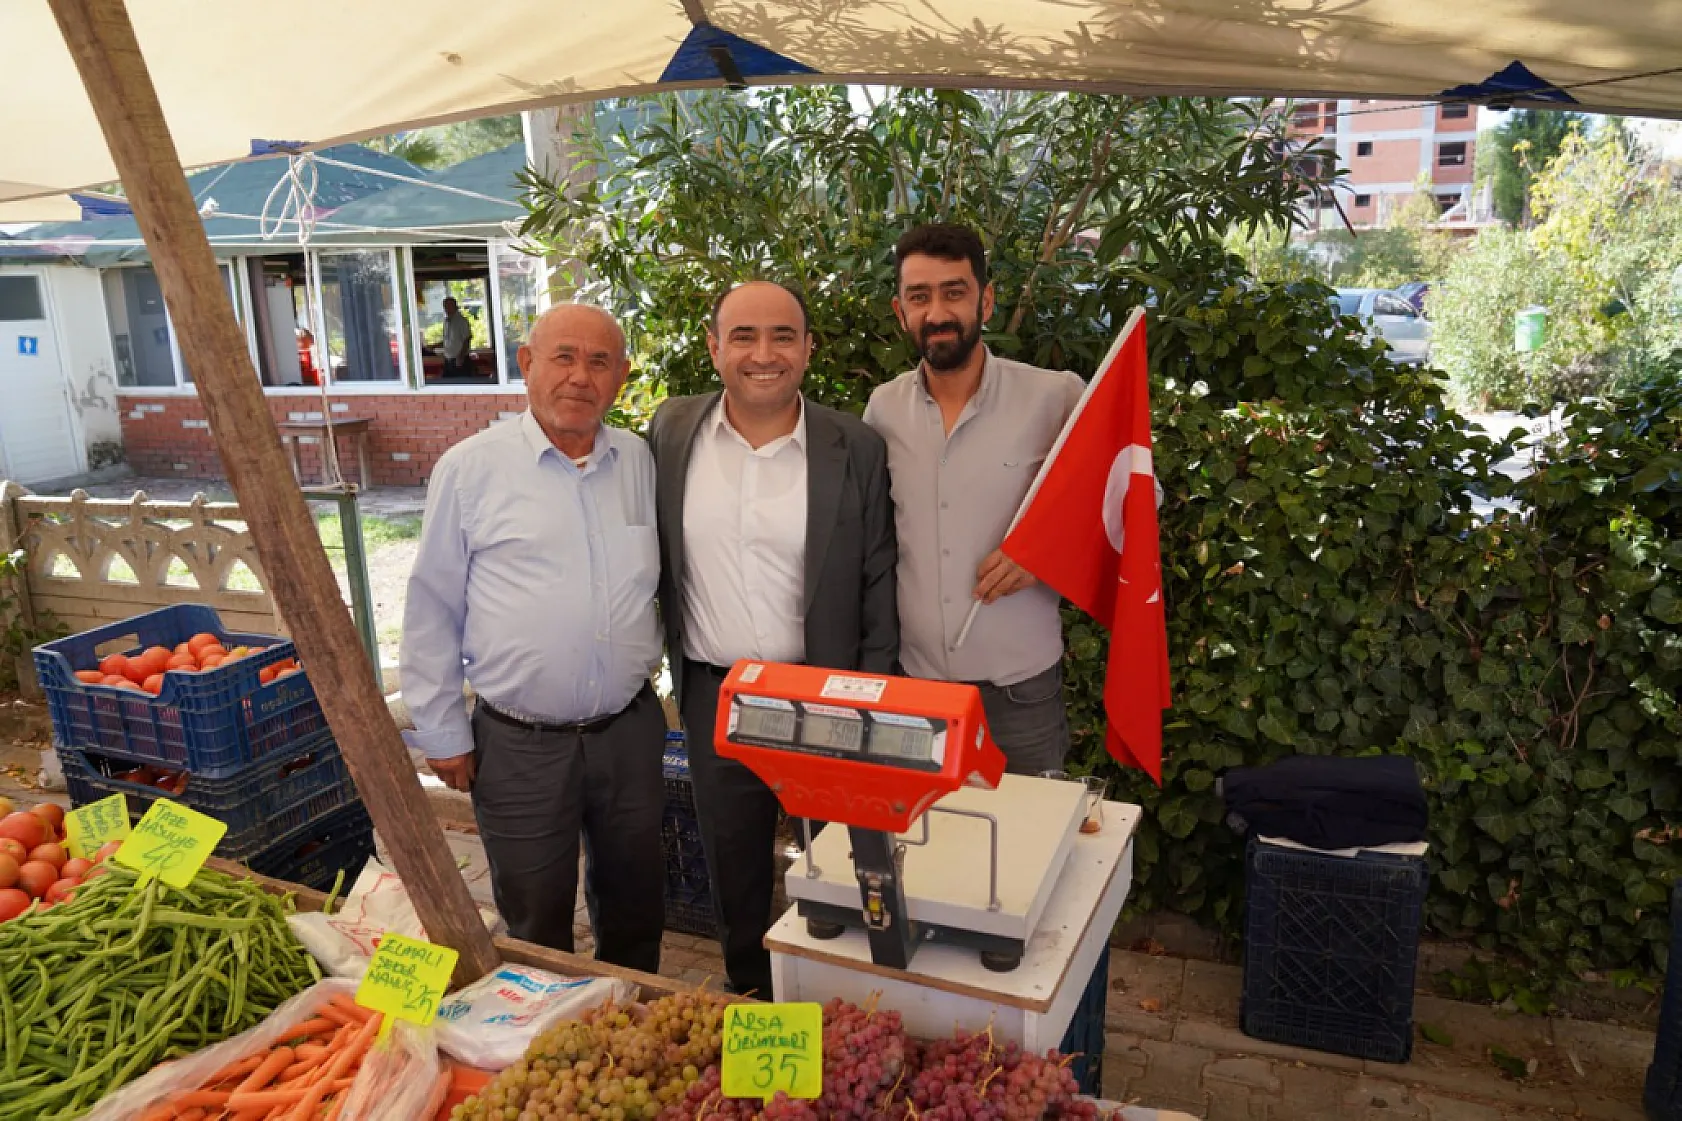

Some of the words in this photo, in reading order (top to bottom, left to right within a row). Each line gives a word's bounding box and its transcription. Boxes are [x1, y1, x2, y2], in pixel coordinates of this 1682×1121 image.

[142, 842, 186, 869] 40
[403, 984, 440, 1024] 25
[752, 1053, 810, 1090] 35
